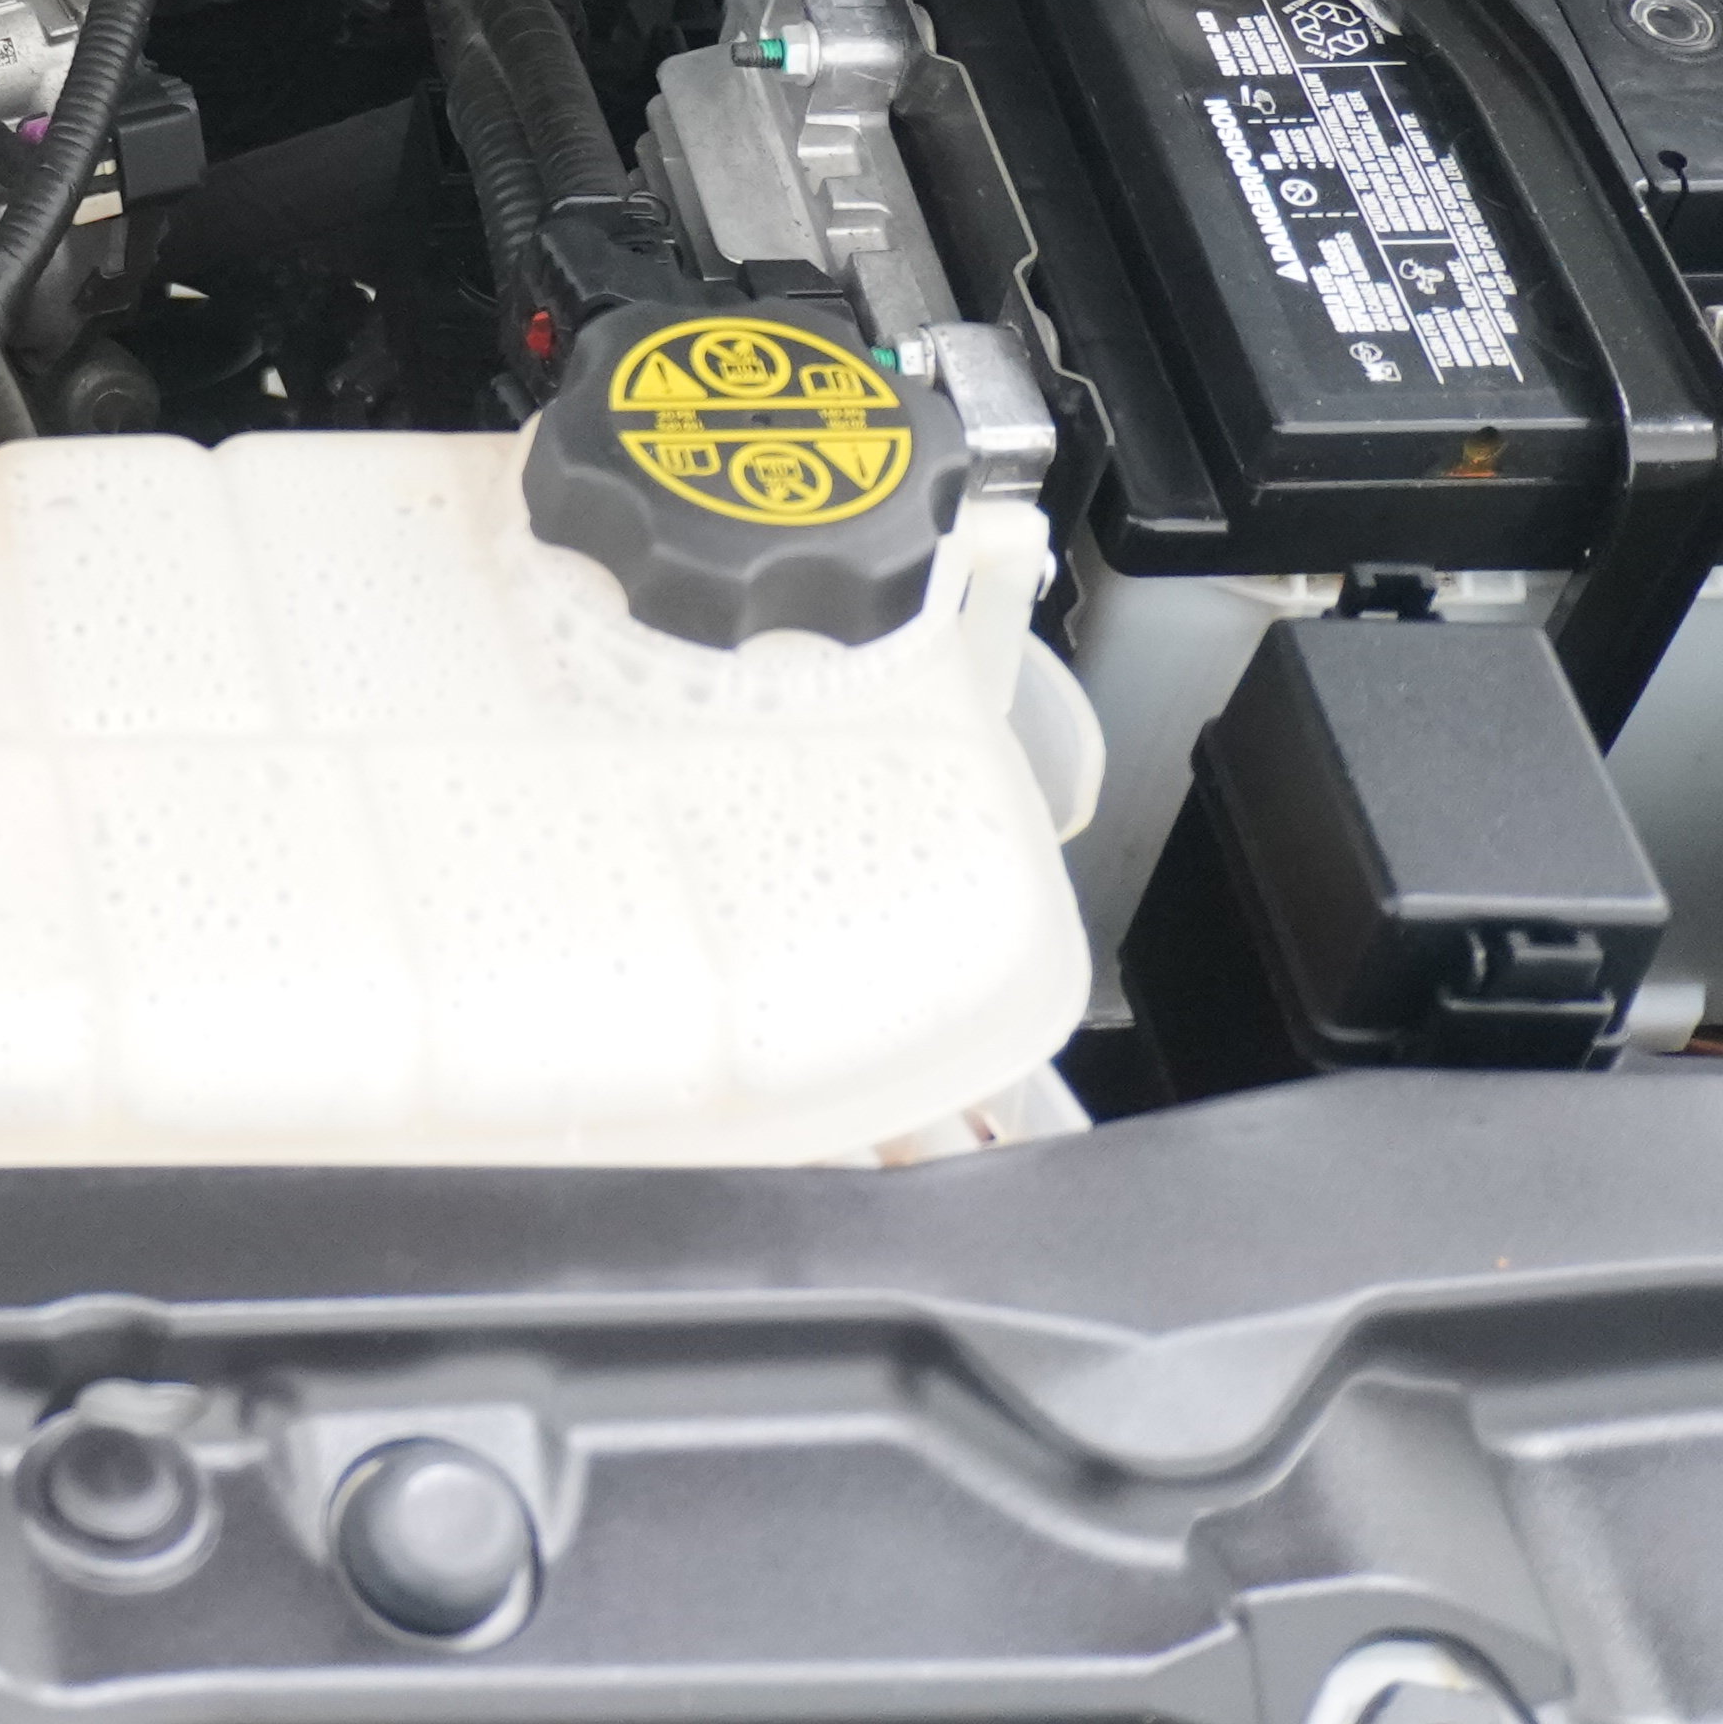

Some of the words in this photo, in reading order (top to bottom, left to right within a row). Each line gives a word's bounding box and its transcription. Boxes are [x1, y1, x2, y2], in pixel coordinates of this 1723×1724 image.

[1195, 10, 1220, 33] ACID
[1236, 16, 1255, 30] OR
[1253, 14, 1279, 43] BURNS
[1206, 33, 1239, 77] SULFURIC
[1225, 30, 1250, 57] CAUSE
[1242, 29, 1276, 75] BLINDNESS
[1305, 44, 1334, 60] LEAD
[1237, 57, 1258, 75] CAN
[1266, 42, 1293, 75] SEVERE
[1303, 72, 1332, 106] FOLLOW
[1269, 128, 1298, 164] SPARKS
[1287, 128, 1316, 163] FLAMES
[1259, 153, 1283, 170] NO
[1206, 100, 1298, 261] DANGER/POISON
[1309, 265, 1339, 294] EYES
